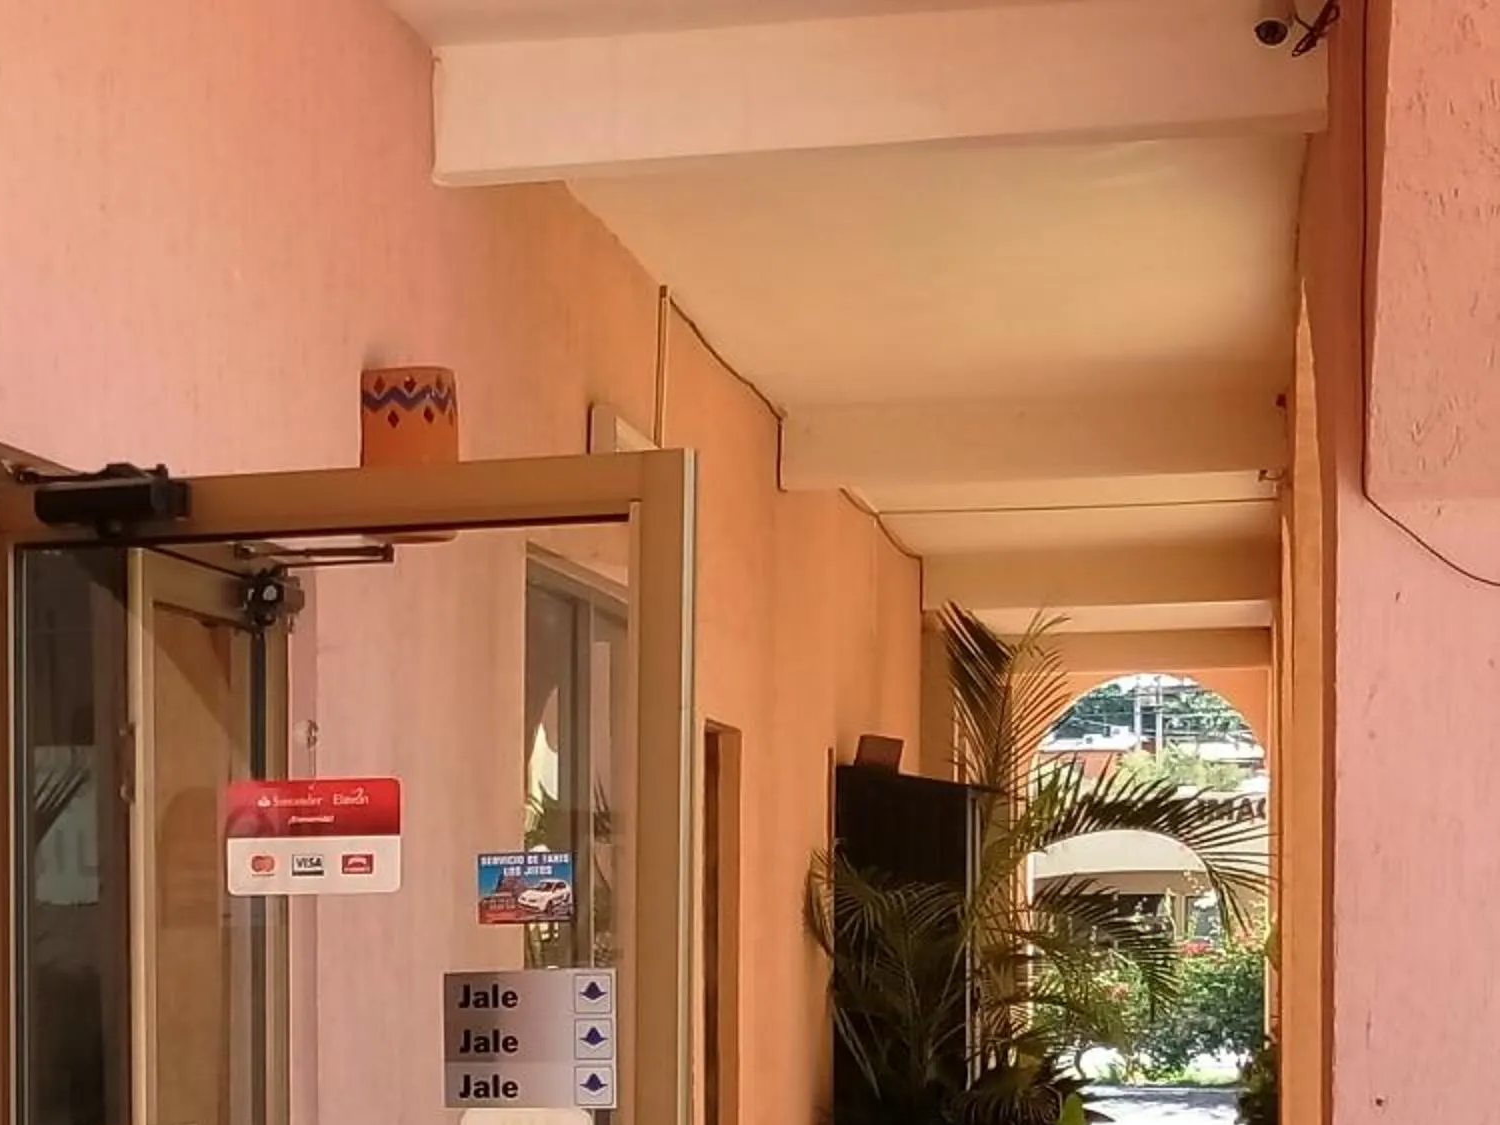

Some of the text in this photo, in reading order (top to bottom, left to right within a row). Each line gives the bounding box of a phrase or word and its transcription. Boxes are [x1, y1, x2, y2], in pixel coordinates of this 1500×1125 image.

[295, 856, 323, 869] VISA
[458, 983, 519, 1009] Jale
[459, 1028, 519, 1054] Jale
[459, 1073, 519, 1099] Jale
